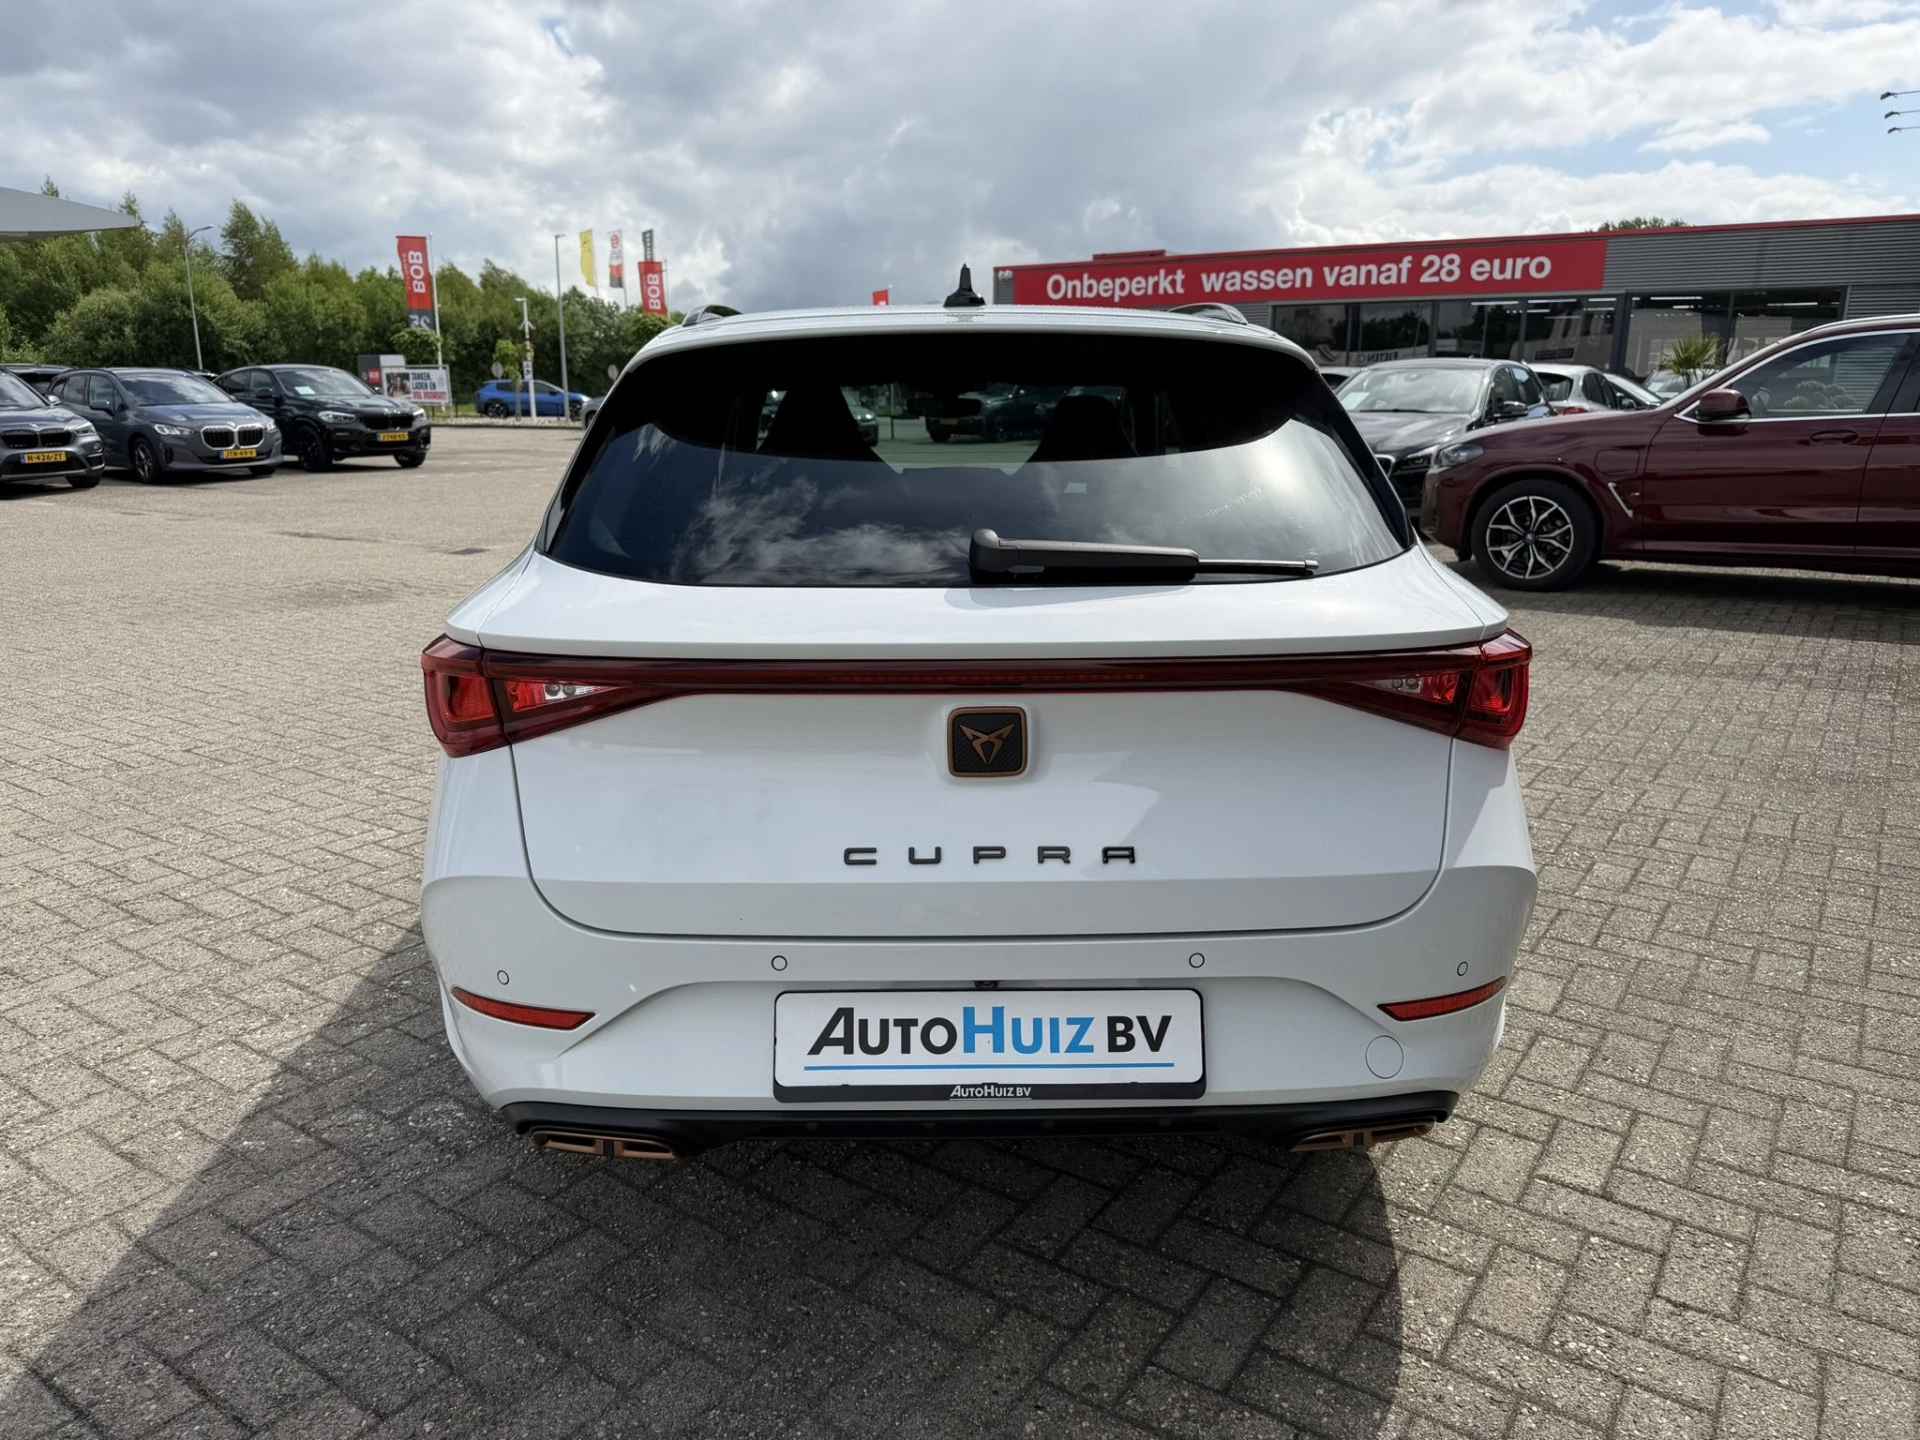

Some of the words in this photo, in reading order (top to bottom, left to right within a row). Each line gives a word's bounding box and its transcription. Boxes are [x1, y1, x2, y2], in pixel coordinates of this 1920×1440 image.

[408, 250, 426, 293] BOB
[1045, 268, 1185, 303] Onbeperkt
[1201, 266, 1313, 294] wassen
[1322, 255, 1412, 288] vanaf
[1420, 253, 1461, 284] 28
[1469, 254, 1552, 281] euro
[646, 273, 661, 310] BOB
[843, 845, 1136, 865] CUPRA
[1106, 1014, 1173, 1053] BV
[1016, 1086, 1032, 1097] BV
